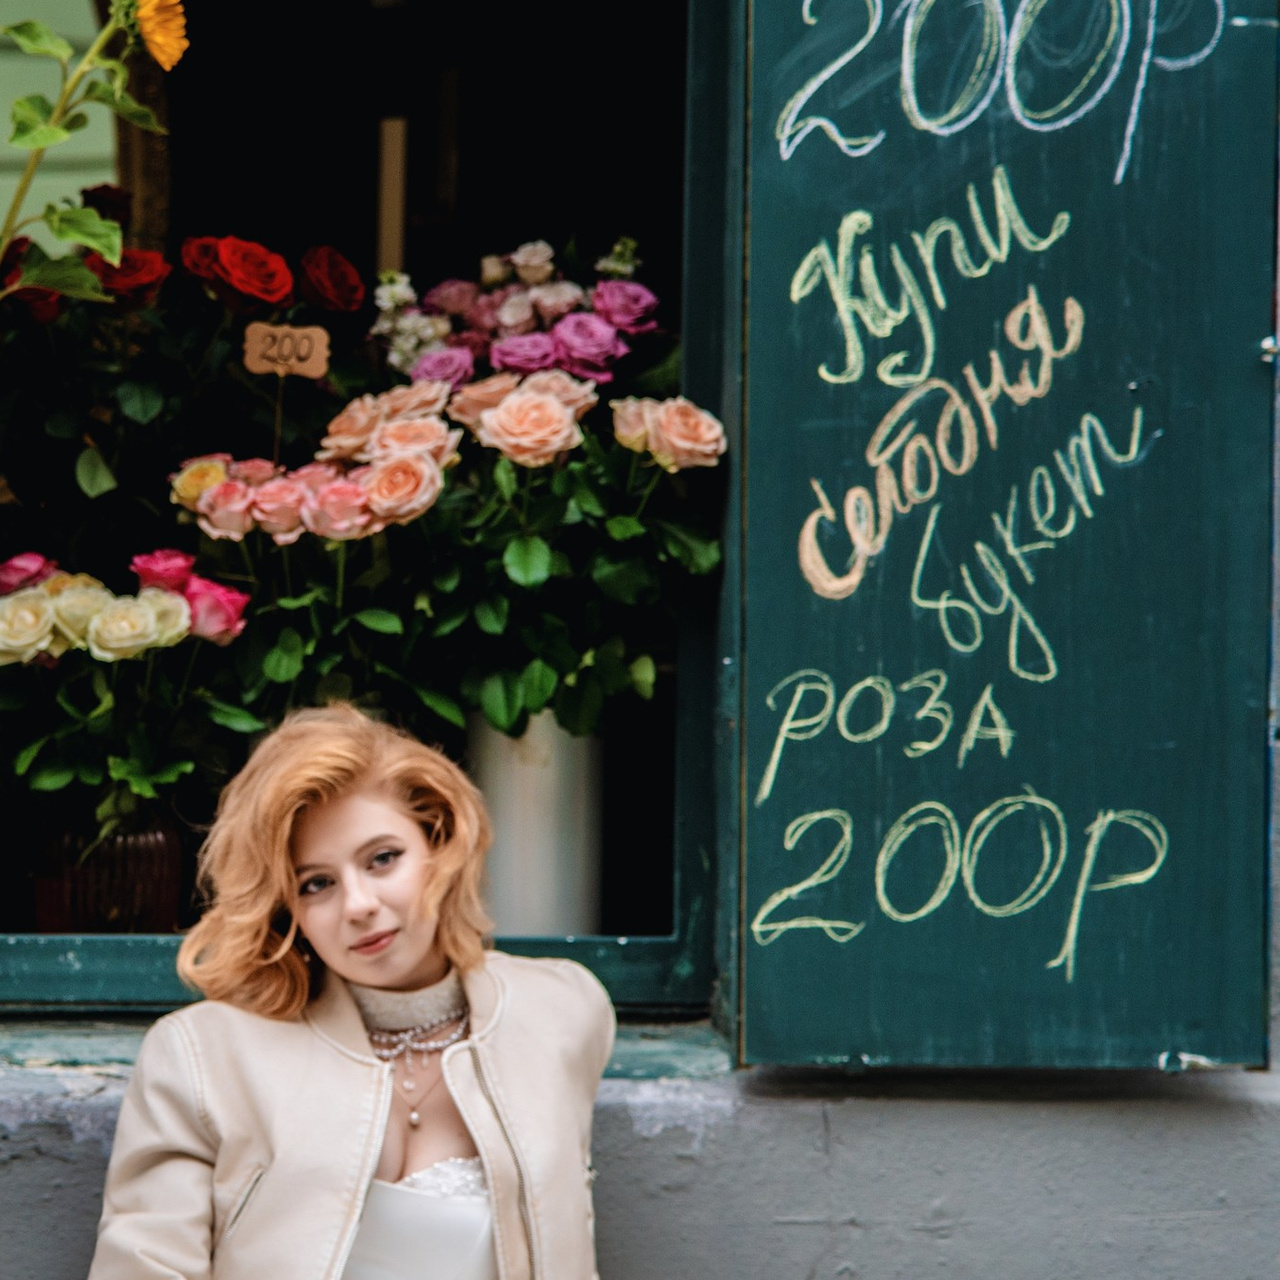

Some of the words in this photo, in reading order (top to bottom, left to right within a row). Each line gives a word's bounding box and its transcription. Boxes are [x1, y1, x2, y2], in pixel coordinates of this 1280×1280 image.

[259, 331, 315, 365] 200
[790, 164, 1071, 386] Купи
[911, 405, 1163, 683] букет
